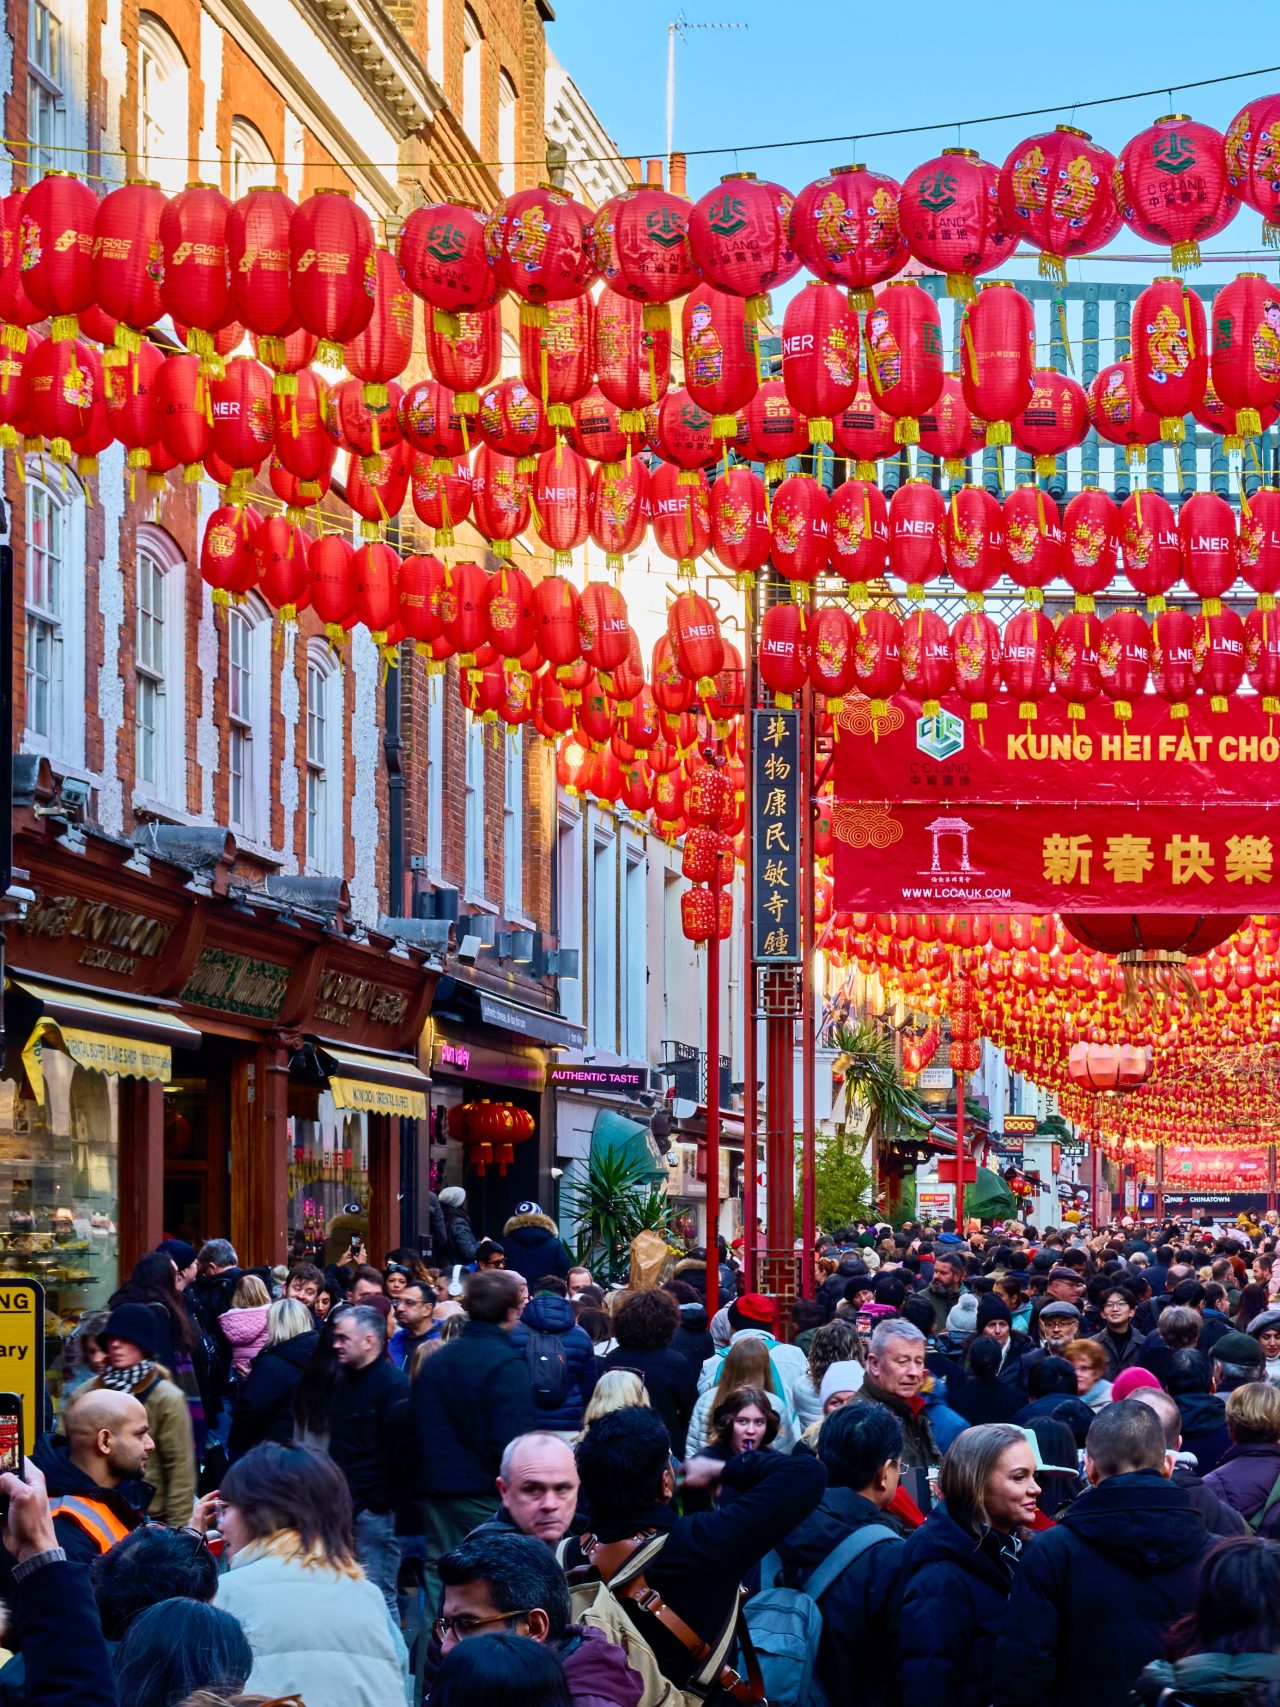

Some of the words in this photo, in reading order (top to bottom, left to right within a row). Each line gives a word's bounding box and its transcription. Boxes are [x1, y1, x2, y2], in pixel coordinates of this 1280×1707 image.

[538, 486, 577, 501] LNER
[652, 498, 688, 517] LNER
[895, 519, 935, 535] LNER
[1190, 536, 1229, 551] LNER
[681, 624, 716, 641] LNER
[762, 640, 794, 654] LNER
[1004, 646, 1035, 659] LNER
[1213, 637, 1244, 654] LNER
[1007, 733, 1093, 761] KUNG
[1101, 734, 1151, 761] HEI
[1159, 735, 1213, 762] FAT
[1042, 833, 1274, 885] 新春快樂
[902, 888, 1011, 898] WWW.LCCAUK.COM
[551, 1070, 607, 1082] AUTHENTIC
[609, 1073, 640, 1084] TASTE
[1046, 1093, 1054, 1114] ZHA
[1141, 1195, 1149, 1207] P
